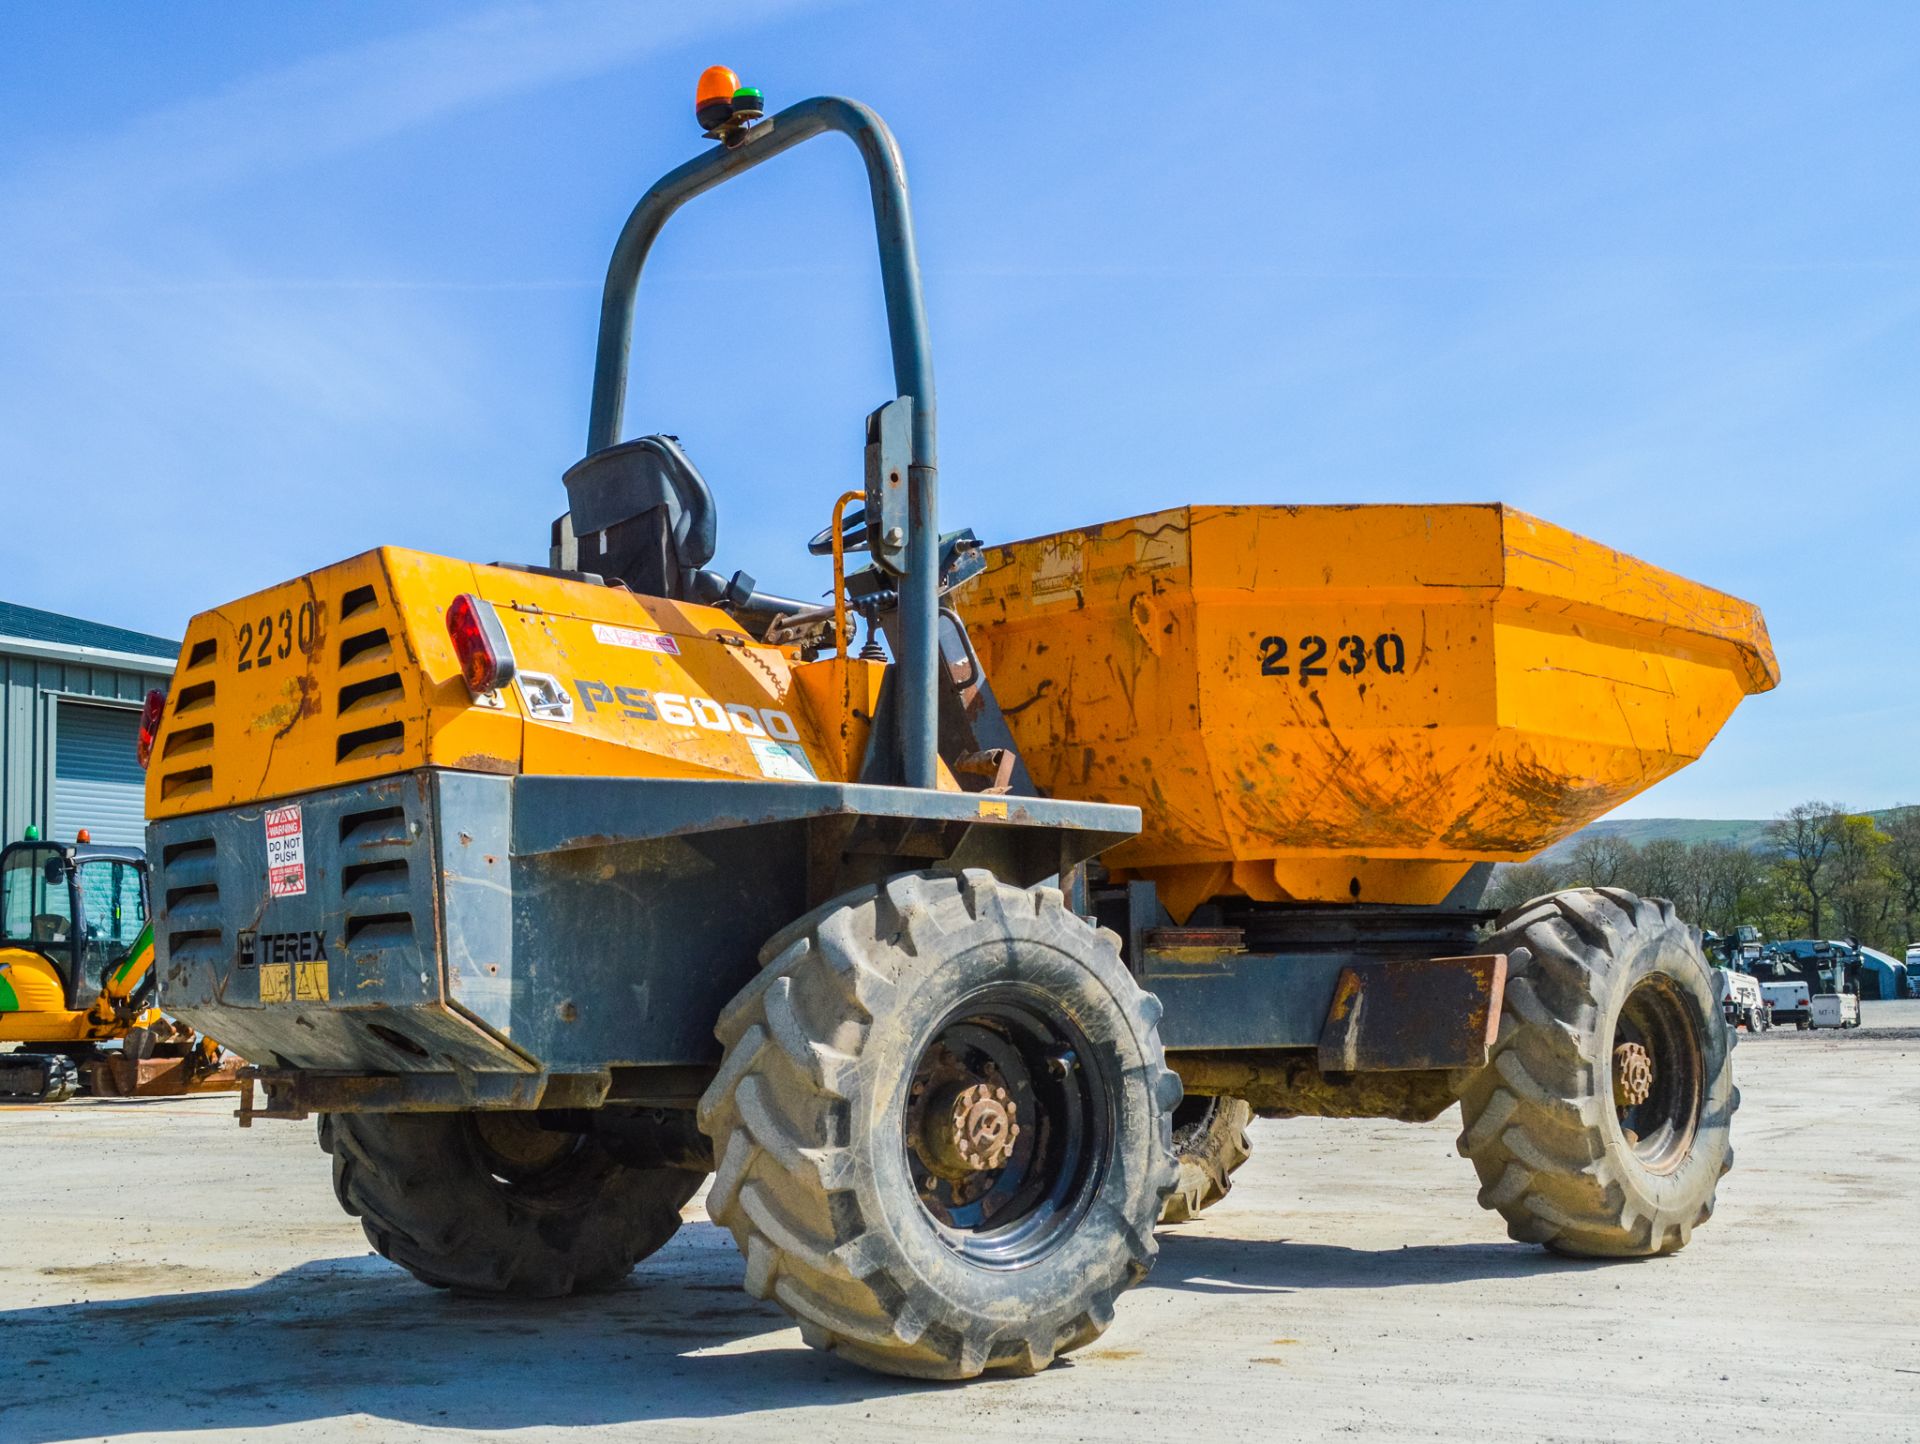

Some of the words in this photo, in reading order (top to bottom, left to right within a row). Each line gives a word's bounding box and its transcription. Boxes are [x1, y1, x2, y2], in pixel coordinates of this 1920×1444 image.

[238, 601, 315, 672] 2230
[1259, 633, 1405, 676] 2230
[574, 679, 800, 742] PS6000
[268, 821, 298, 837] WARNING
[269, 841, 281, 853] DO
[283, 837, 300, 850] NOT
[274, 850, 297, 863] PUSH
[260, 930, 328, 963] TEREX
